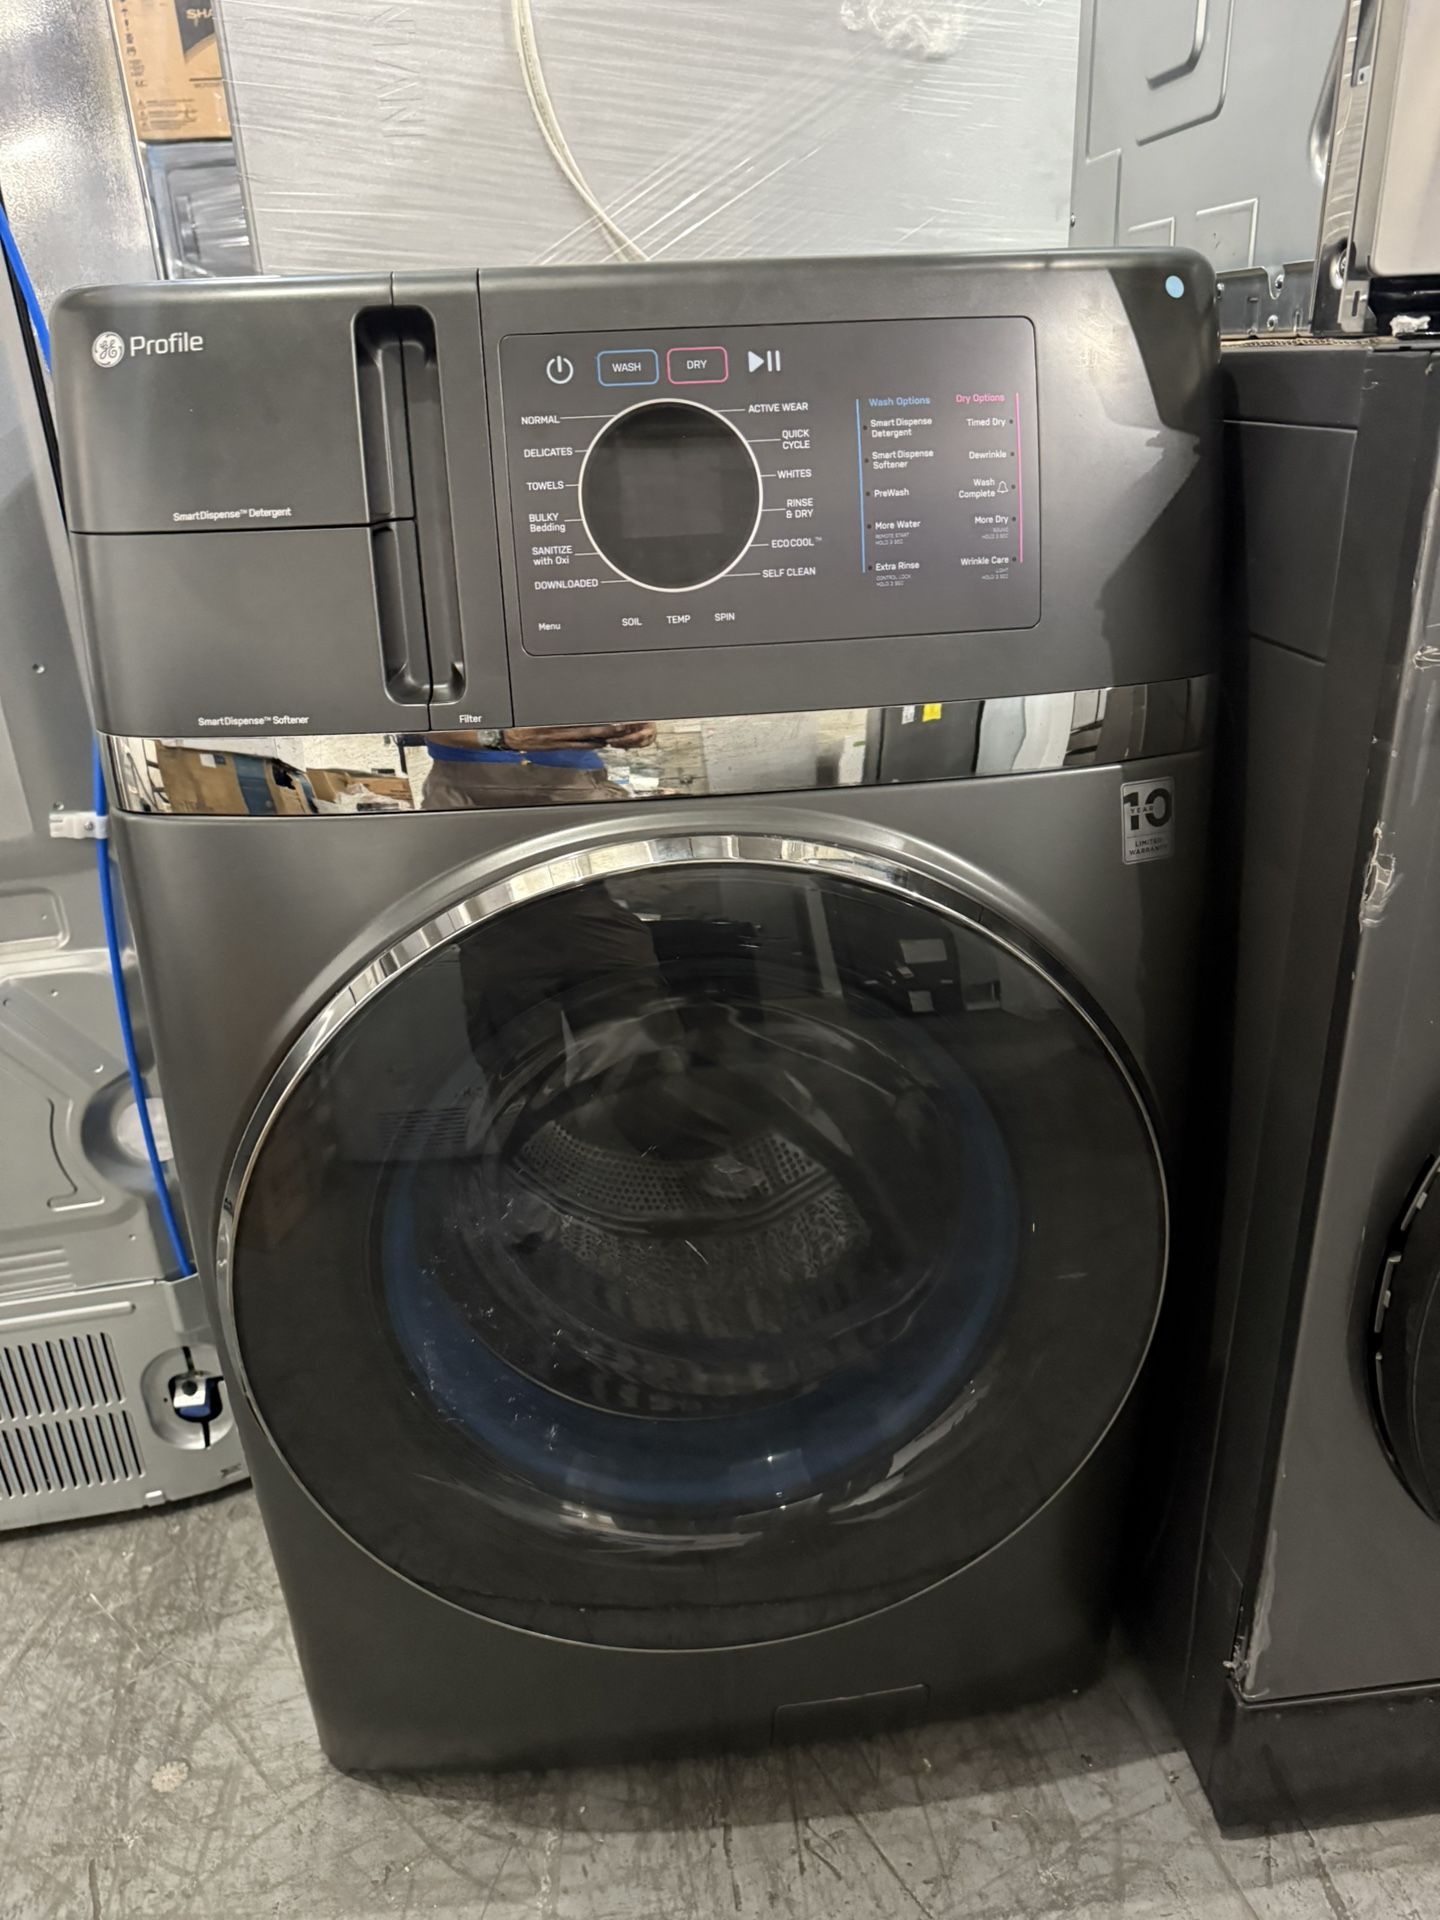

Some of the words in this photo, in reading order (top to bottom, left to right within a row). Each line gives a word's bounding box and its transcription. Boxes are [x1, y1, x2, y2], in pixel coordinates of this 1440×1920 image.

[130, 331, 204, 357] Profile
[612, 362, 642, 373] WASH
[686, 359, 707, 370] DRY
[868, 397, 894, 407] Wash
[896, 395, 931, 407] Options
[956, 394, 971, 404] Dry
[973, 393, 1005, 404] Options
[748, 403, 780, 413] ACTIVE
[781, 402, 809, 412] WEAR
[521, 415, 560, 425] NORMAL
[870, 419, 895, 428] Smart
[895, 417, 933, 427] Dispense
[966, 417, 990, 427] Timed
[992, 417, 1006, 427] Dry
[781, 428, 810, 440] QUICK
[871, 428, 912, 438] Detergent
[782, 440, 811, 450] CYCLE
[523, 447, 573, 458] DELICATES
[872, 450, 896, 460] Smart
[897, 449, 934, 459] Dispense
[968, 450, 1007, 460] Dewrinkle
[872, 460, 908, 470] Softener
[777, 468, 812, 479] WHITES
[526, 481, 564, 491] TOWELS
[973, 478, 995, 486] Wash
[874, 488, 910, 498] PreWash
[958, 489, 996, 499] Complete
[786, 498, 814, 508] RINSE
[248, 506, 292, 519] Detergent
[528, 513, 559, 523] BULKY
[785, 510, 793, 519] &
[794, 509, 814, 519] DRY
[875, 521, 895, 531] More
[896, 519, 921, 529] Water
[974, 515, 994, 525] More
[995, 514, 1009, 525] Dry
[530, 523, 566, 534] Bedding
[531, 545, 573, 556] SANITIZE
[533, 557, 553, 566] with
[555, 555, 570, 565] Oxi
[875, 562, 897, 572] Extra
[897, 560, 920, 570] Rinse
[960, 556, 989, 566] Wrinkle
[991, 555, 1009, 565] Care
[762, 568, 785, 578] SELF
[786, 566, 816, 577] CLEAN
[534, 578, 599, 590] DOWNLOADED
[622, 617, 643, 627] SOIL
[666, 614, 691, 624] TEMP
[714, 612, 735, 622] SPIN
[538, 622, 561, 631] Menu
[272, 714, 310, 725] Softener
[459, 714, 482, 724] Filter
[1123, 788, 1172, 830] 10
